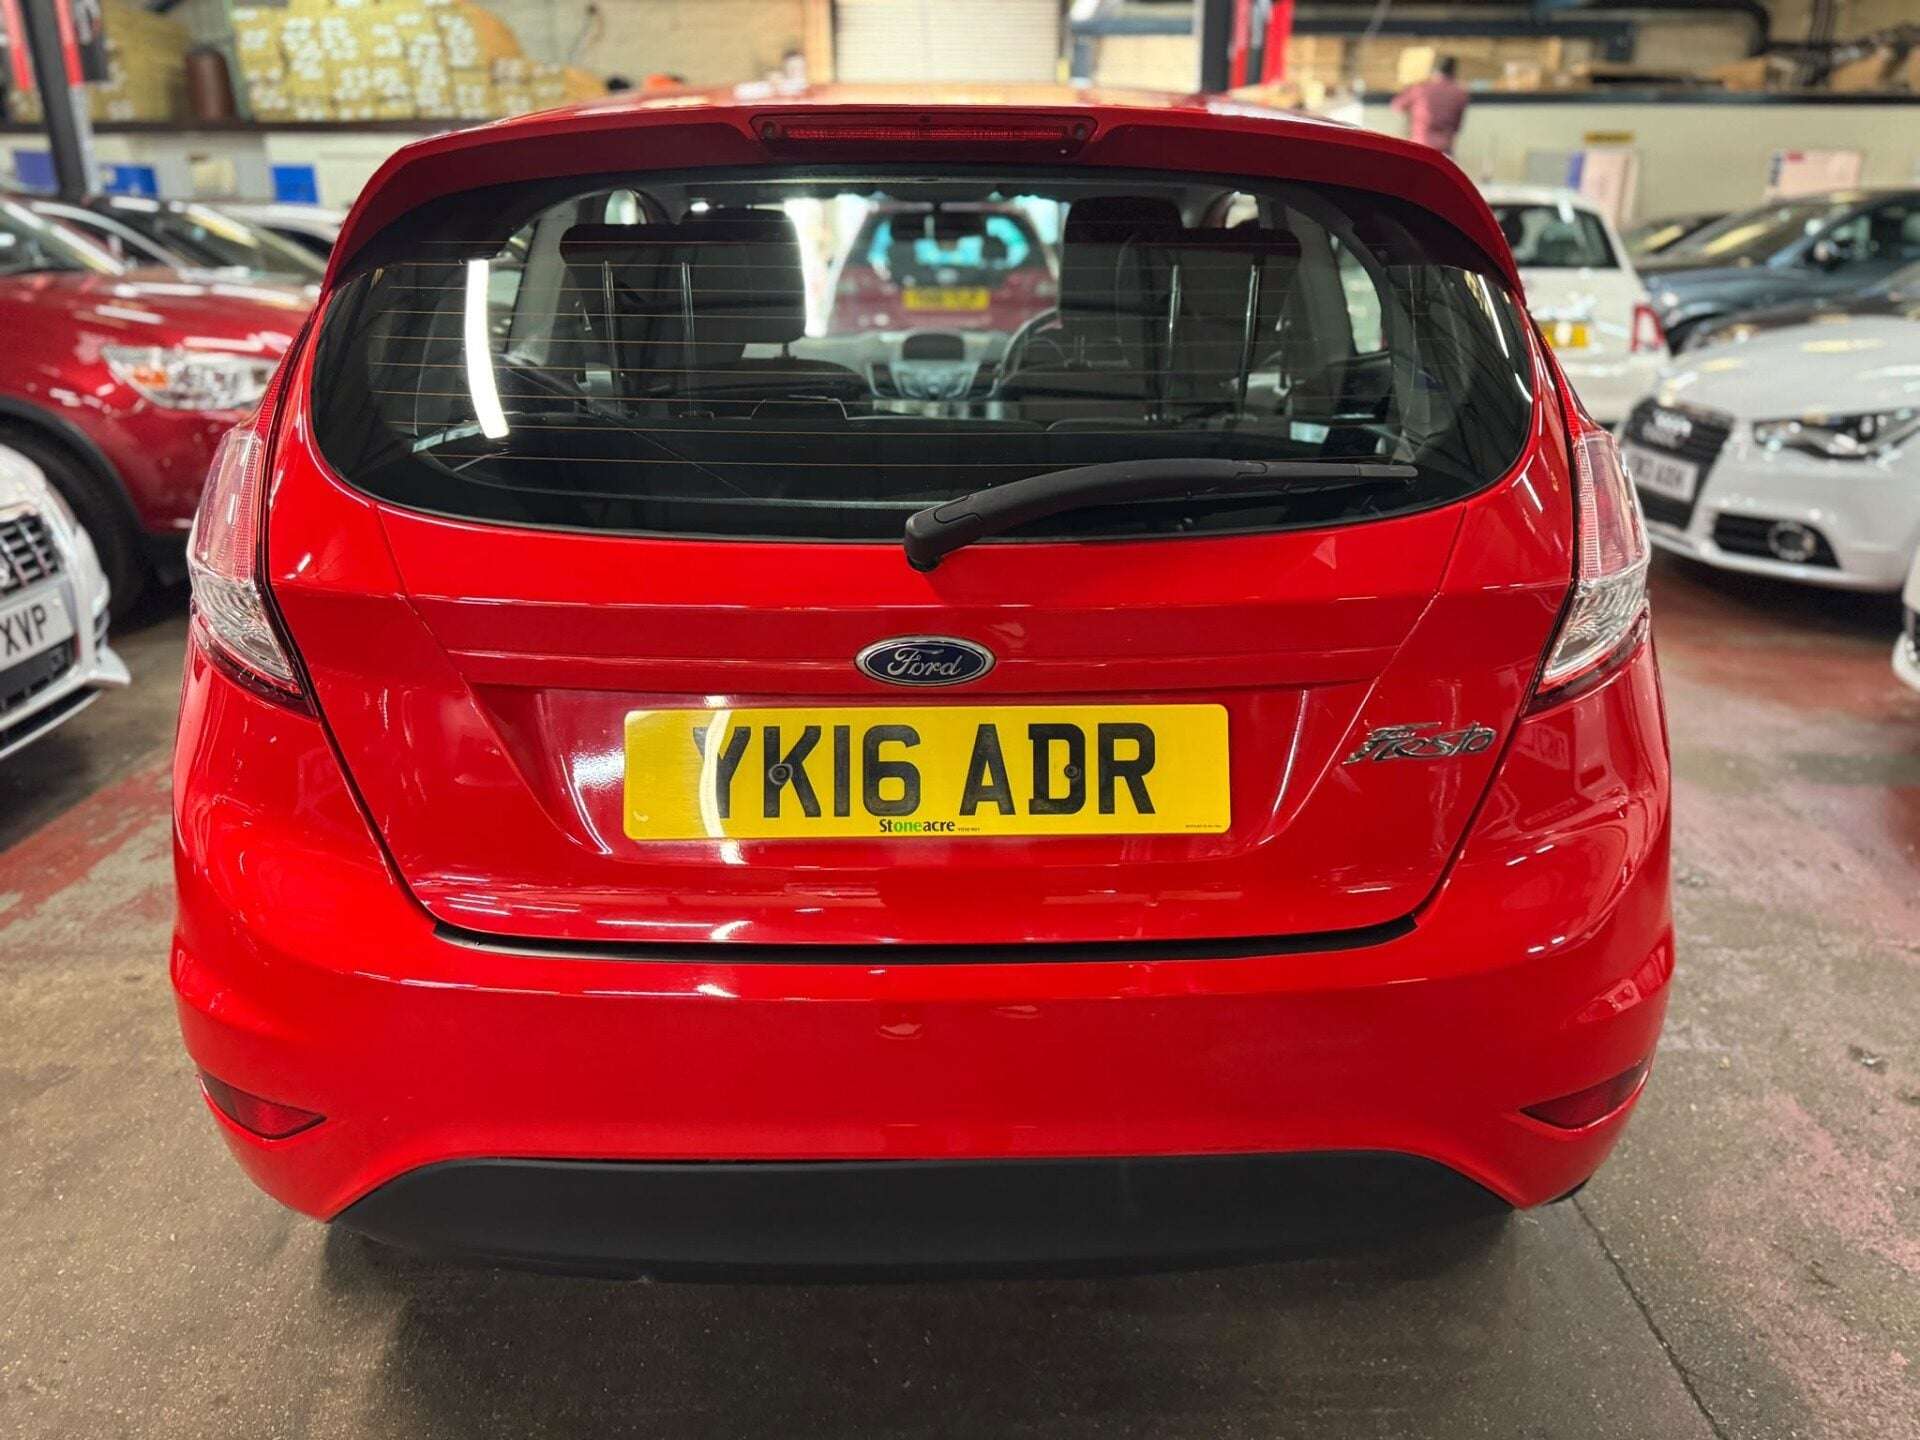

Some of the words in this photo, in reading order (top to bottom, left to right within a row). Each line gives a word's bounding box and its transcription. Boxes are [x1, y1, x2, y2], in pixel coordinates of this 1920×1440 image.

[0, 604, 46, 656] XVP
[887, 647, 963, 676] Ford
[693, 724, 920, 818] YK16
[959, 723, 1156, 815] ADR
[880, 819, 955, 832] Stoneacre
